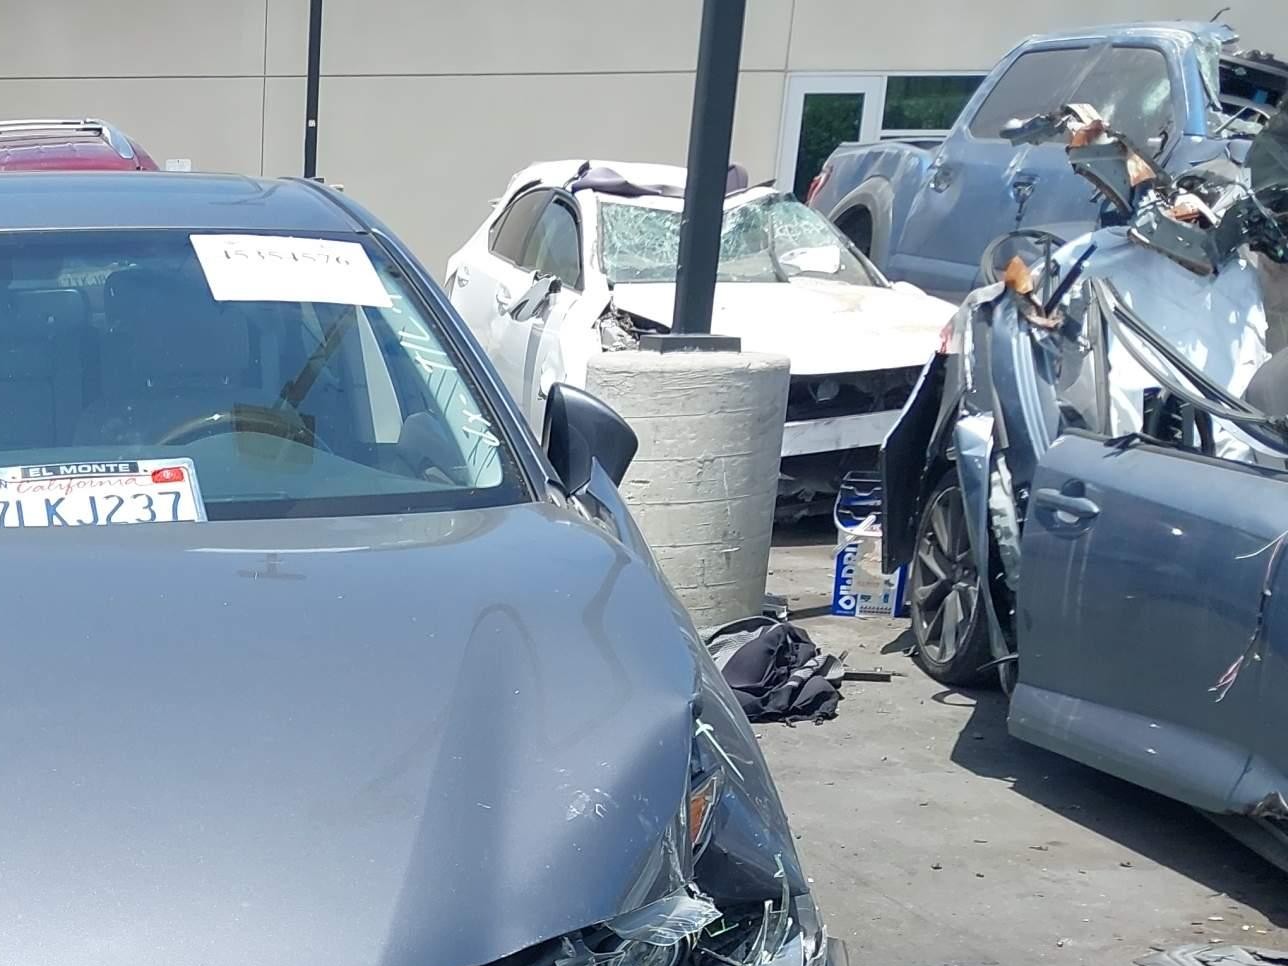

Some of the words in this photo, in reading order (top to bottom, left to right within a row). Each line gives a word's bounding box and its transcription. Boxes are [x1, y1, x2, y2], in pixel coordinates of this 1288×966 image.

[29, 467, 53, 477] EL
[59, 463, 130, 475] MONTE
[16, 477, 140, 496] California
